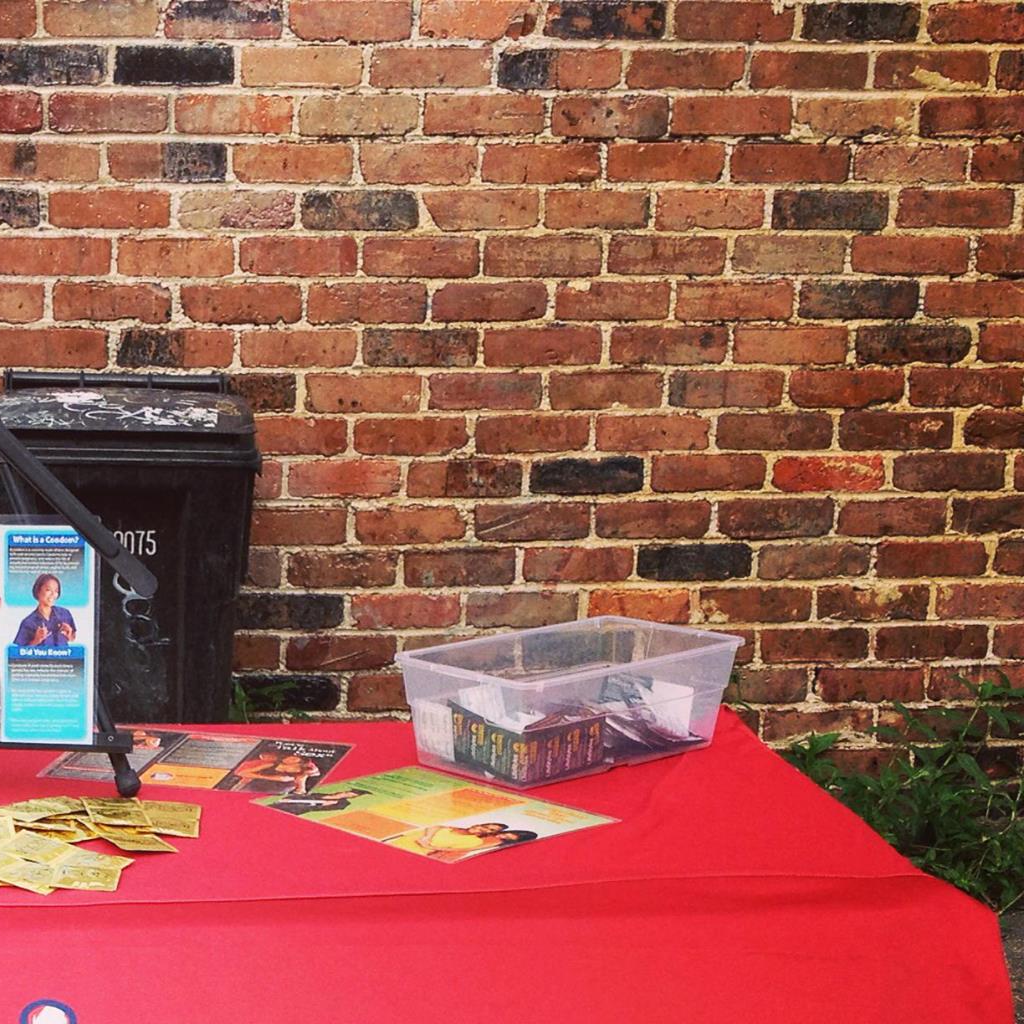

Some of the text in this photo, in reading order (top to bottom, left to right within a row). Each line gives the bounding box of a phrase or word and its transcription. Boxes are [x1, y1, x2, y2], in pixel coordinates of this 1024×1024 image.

[12, 535, 32, 543] What
[33, 535, 38, 543] is
[46, 535, 80, 543] Condom?
[19, 648, 72, 656] Did You Know?
